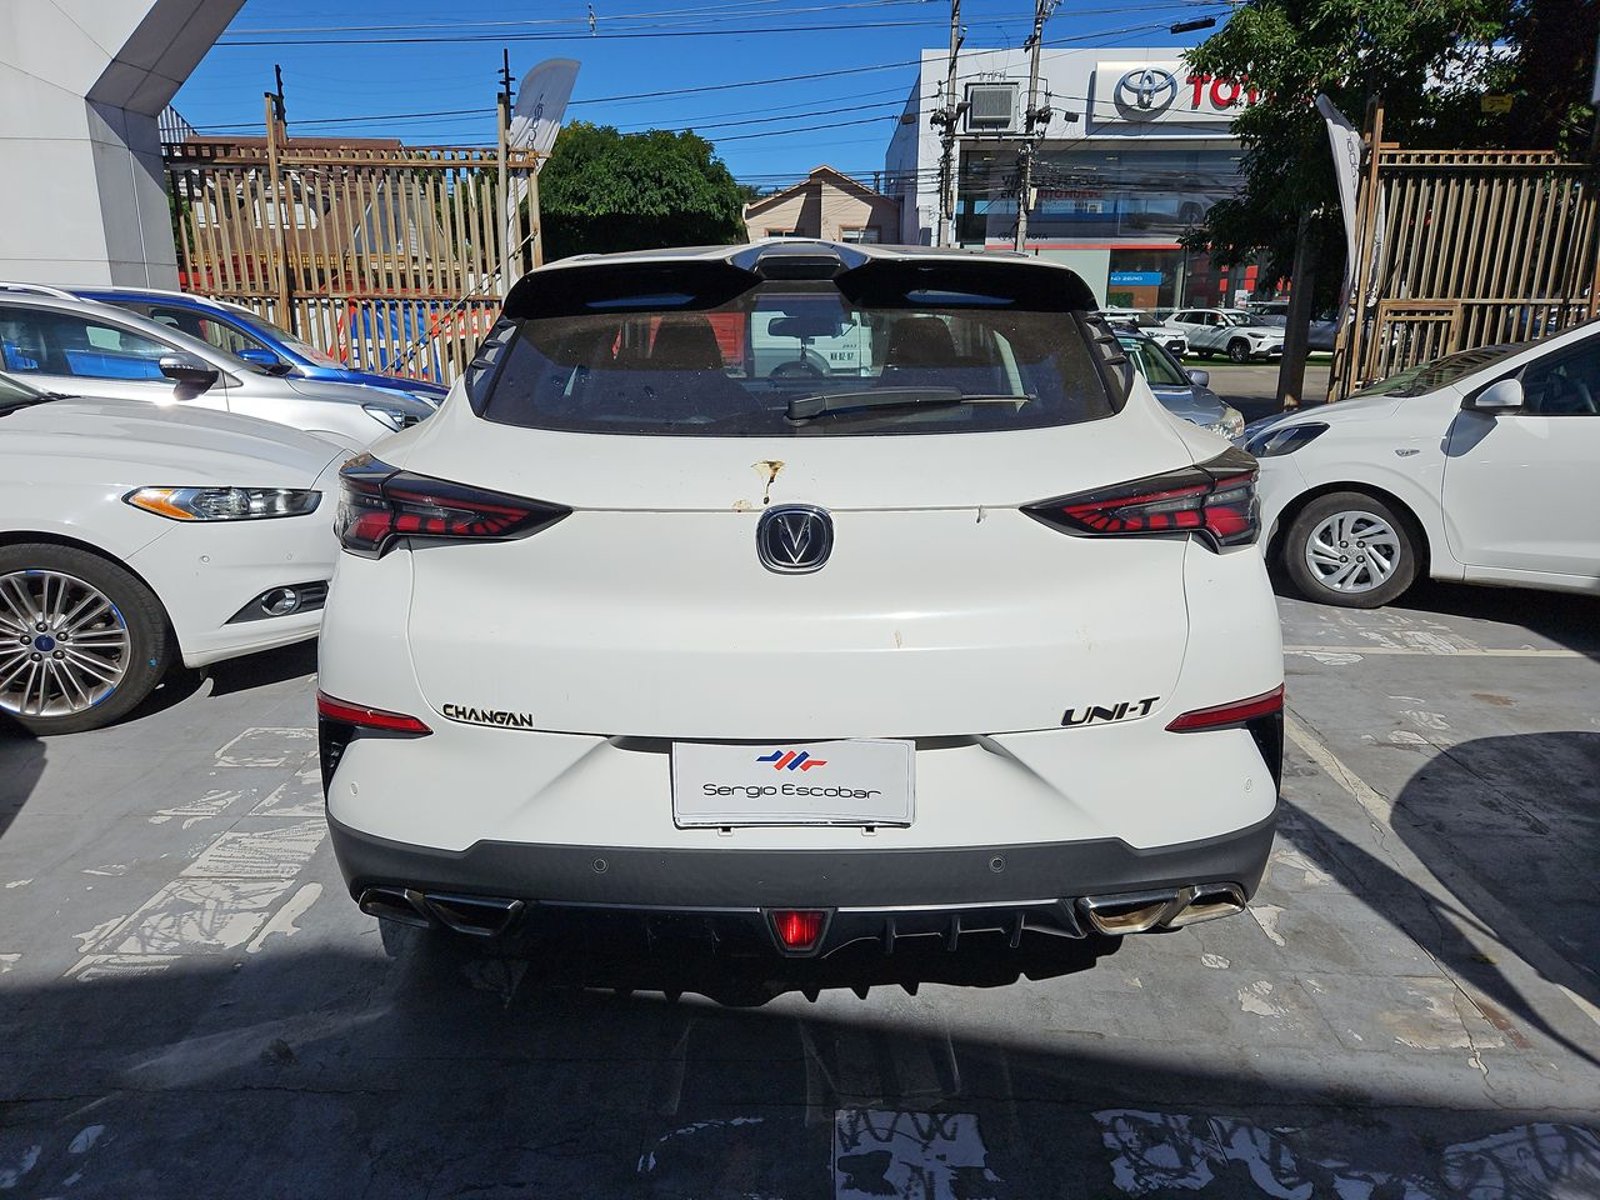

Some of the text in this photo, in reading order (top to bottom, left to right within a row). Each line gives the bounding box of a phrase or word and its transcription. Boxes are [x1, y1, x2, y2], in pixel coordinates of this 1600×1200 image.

[443, 704, 533, 727] CHANGAN
[1061, 696, 1160, 726] UNI-T
[703, 784, 882, 799] Sergio Escobar
